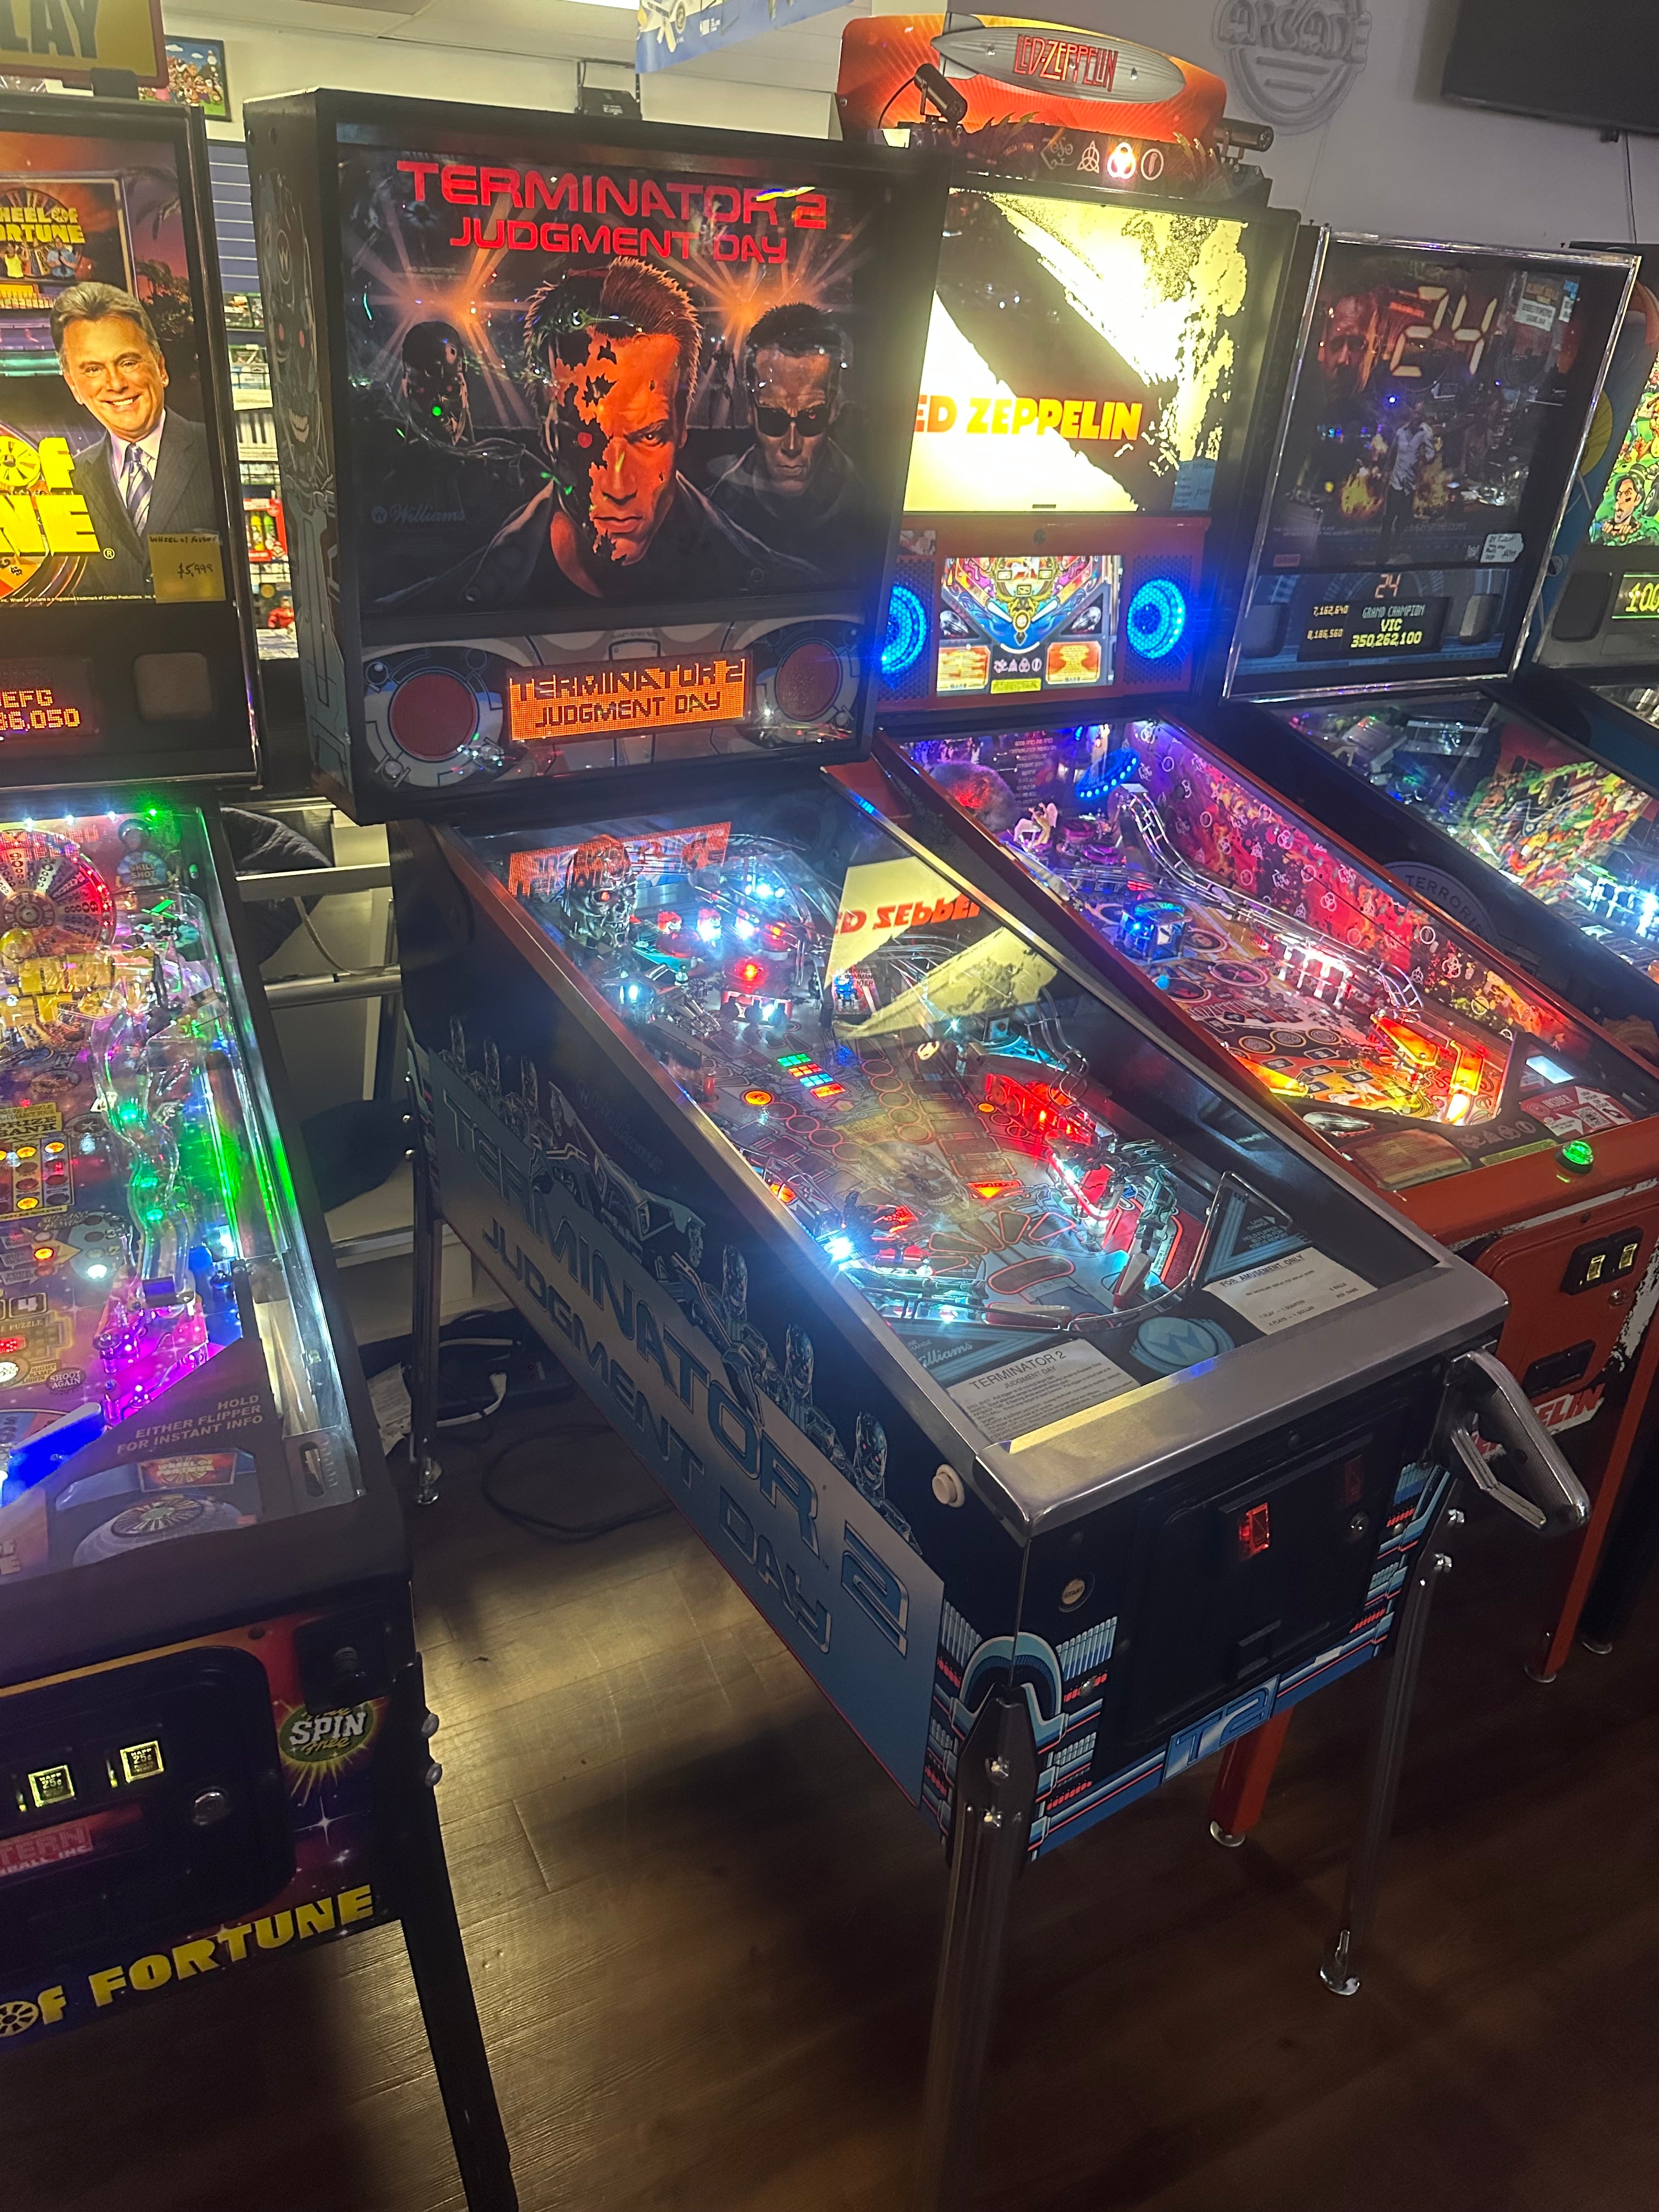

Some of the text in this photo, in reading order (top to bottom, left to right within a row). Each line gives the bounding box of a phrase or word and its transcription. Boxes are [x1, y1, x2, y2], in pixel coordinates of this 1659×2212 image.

[397, 160, 827, 229] TERMINATOR 2
[449, 216, 788, 264] JUDGMENT DAY
[1390, 285, 1499, 377] 24
[966, 397, 1143, 441] ZEPPELIN
[1374, 573, 1402, 599] 24
[1362, 605, 1425, 618] GRAND CHAMPION
[1380, 619, 1403, 632] VIC
[1351, 632, 1423, 648] 350,262,100
[510, 659, 745, 702] TERMINATOR 2
[535, 691, 720, 727] JUDGMENT DAY
[129, 863, 155, 872] SKILL
[131, 871, 156, 879] SHOT
[1542, 1094, 1575, 1109] INSIDER
[1220, 1254, 1305, 1288] FOR AMUSEMENT ONLY
[50, 1370, 81, 1382] SHOOT
[52, 1377, 81, 1390] AGAIN
[442, 1087, 821, 1558] TERMINATOR
[840, 1519, 909, 1659] 2
[969, 1351, 1066, 1390] TERMINATOR 2
[1003, 1365, 1057, 1389] JUDGMENT DAY
[218, 1395, 259, 1410] HOLD
[117, 1414, 264, 1455] FOR INSTANT INFO
[136, 1404, 261, 1439] EITHER FLIPPER
[483, 1215, 832, 1655] JUDGMENT DAY
[289, 1712, 366, 1745] SPIN
[1175, 1688, 1269, 1767] T2
[89, 1884, 374, 2007] FORTUNE
